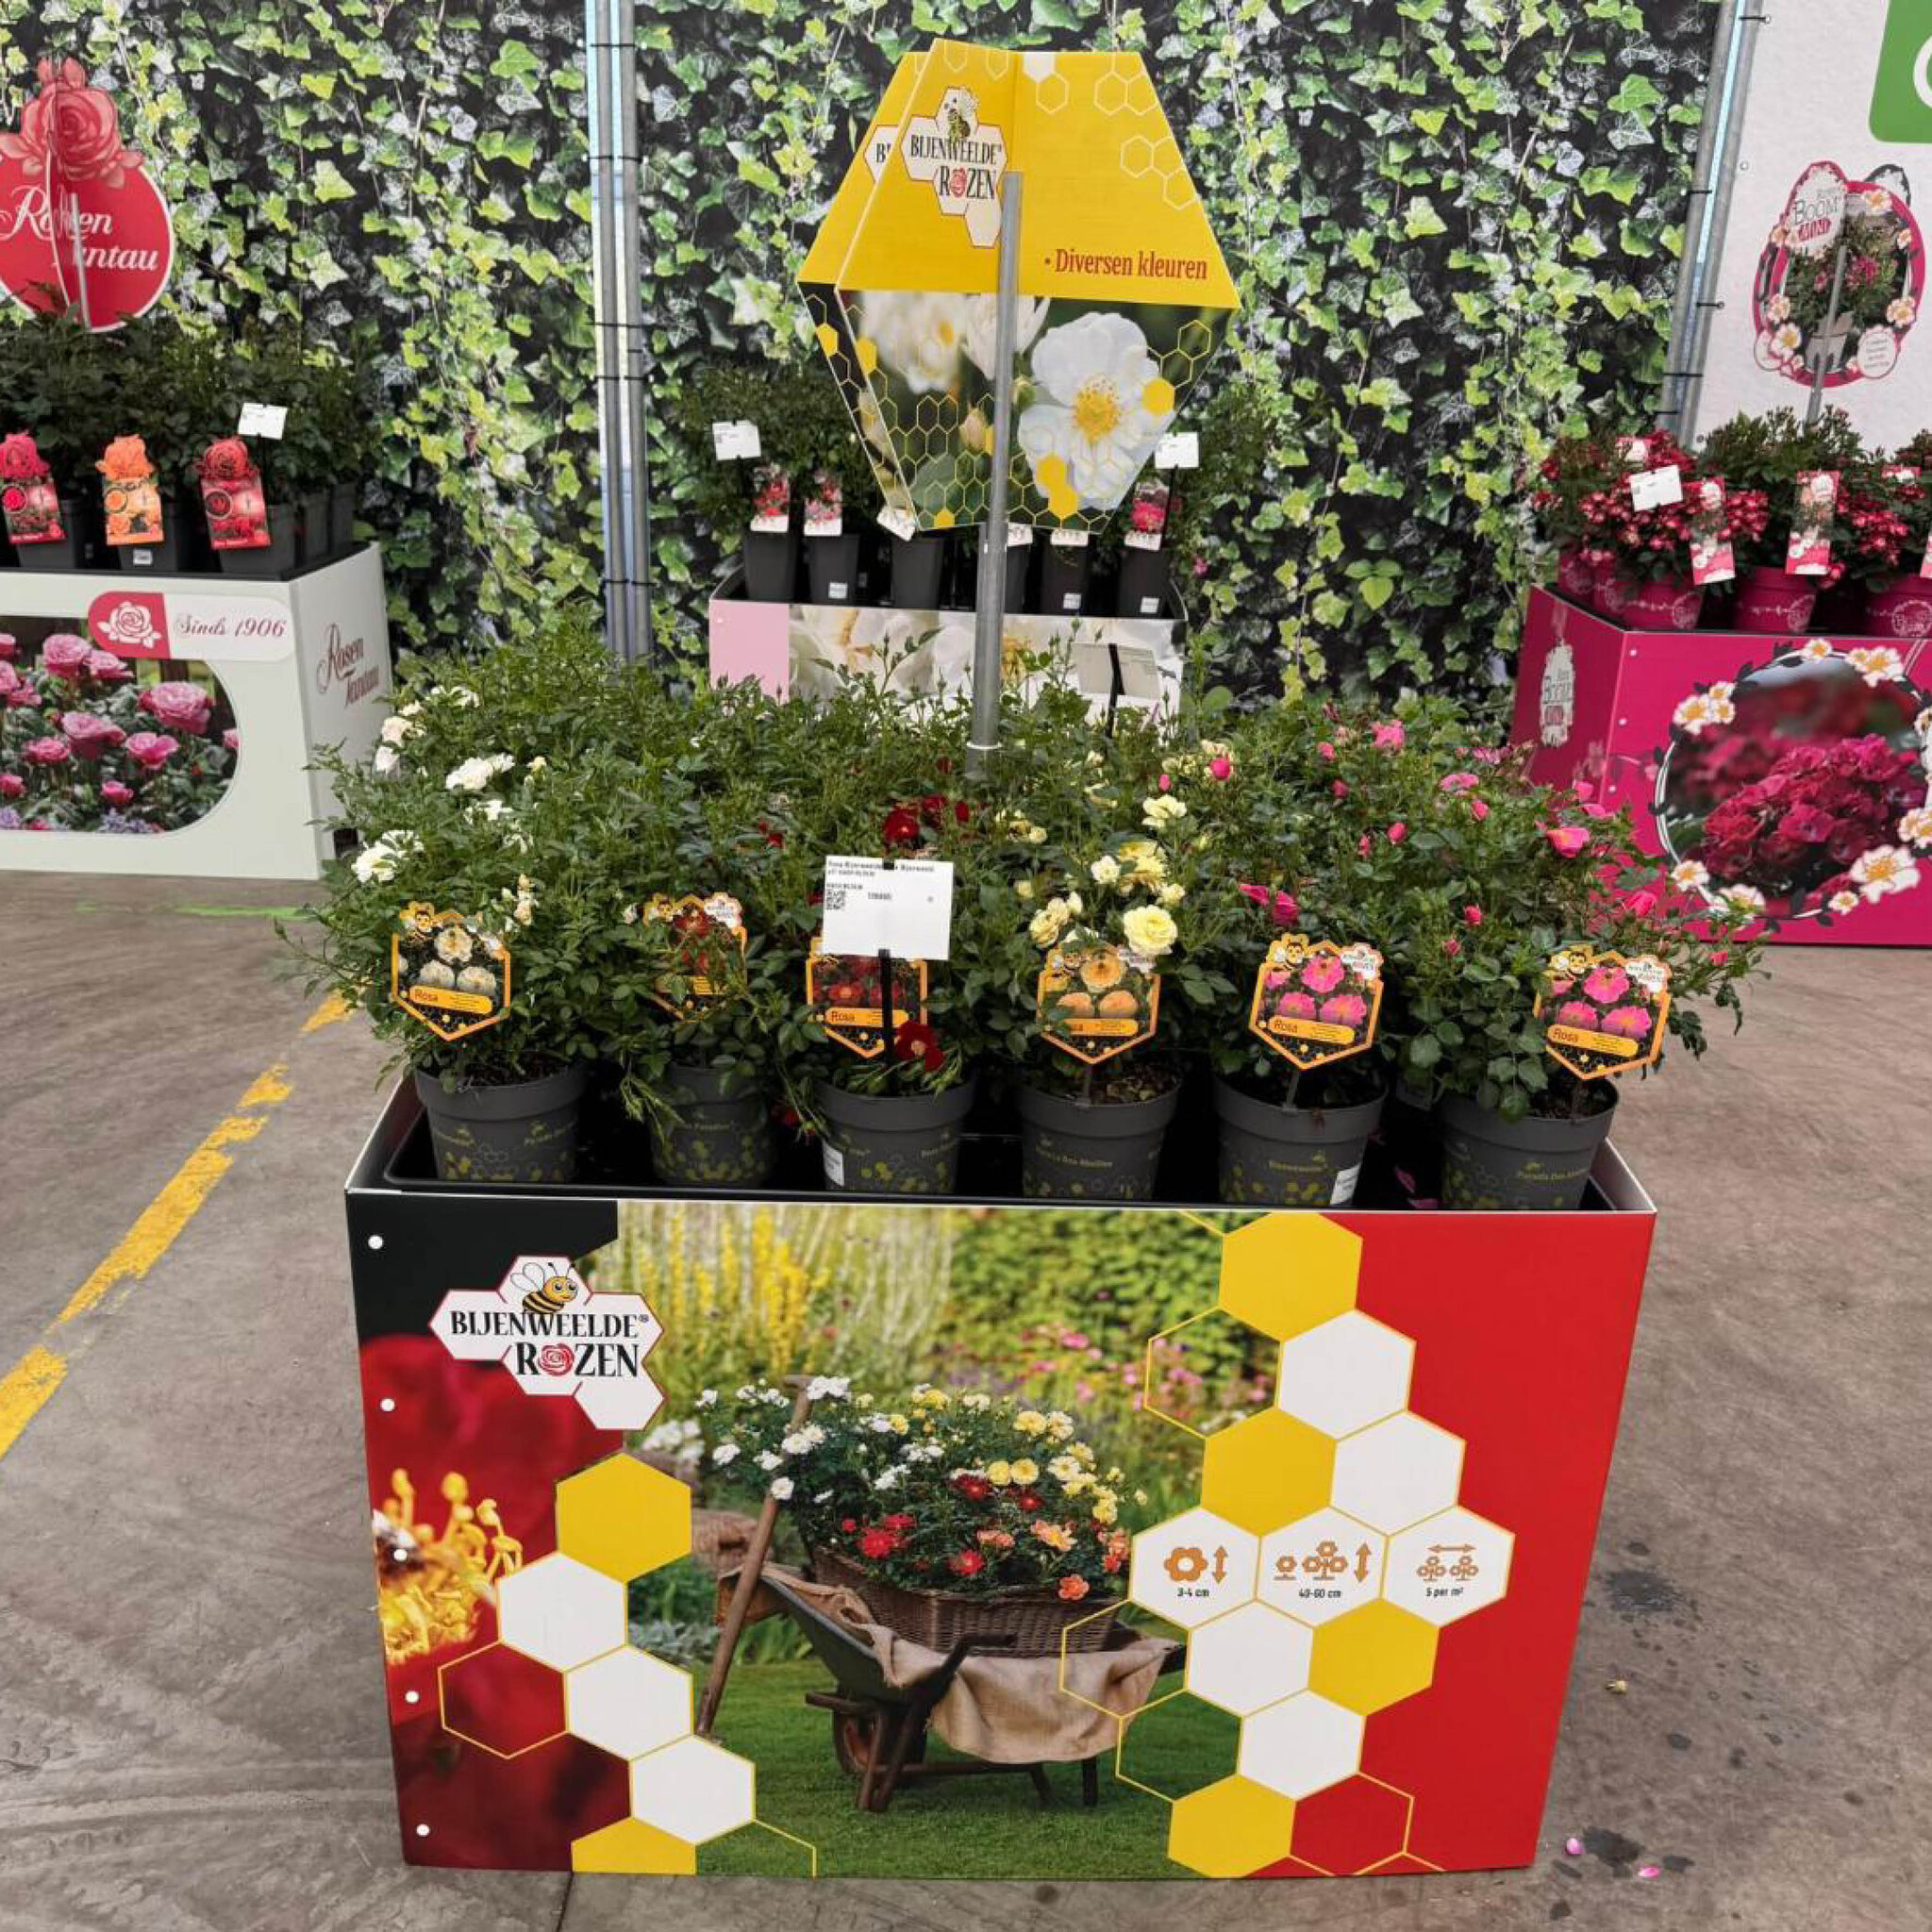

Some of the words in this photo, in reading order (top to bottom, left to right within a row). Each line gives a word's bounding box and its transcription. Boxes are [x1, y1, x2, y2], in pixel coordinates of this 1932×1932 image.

[1055, 247, 1133, 276] Diversen
[1138, 250, 1208, 280] kleuren
[176, 615, 226, 637] Sinds
[234, 616, 288, 638] 1906
[1274, 1020, 1298, 1034] Rosa
[1552, 1027, 1578, 1043] Rosa
[1194, 1588, 1209, 1597] cm
[1327, 1589, 1341, 1598] cm
